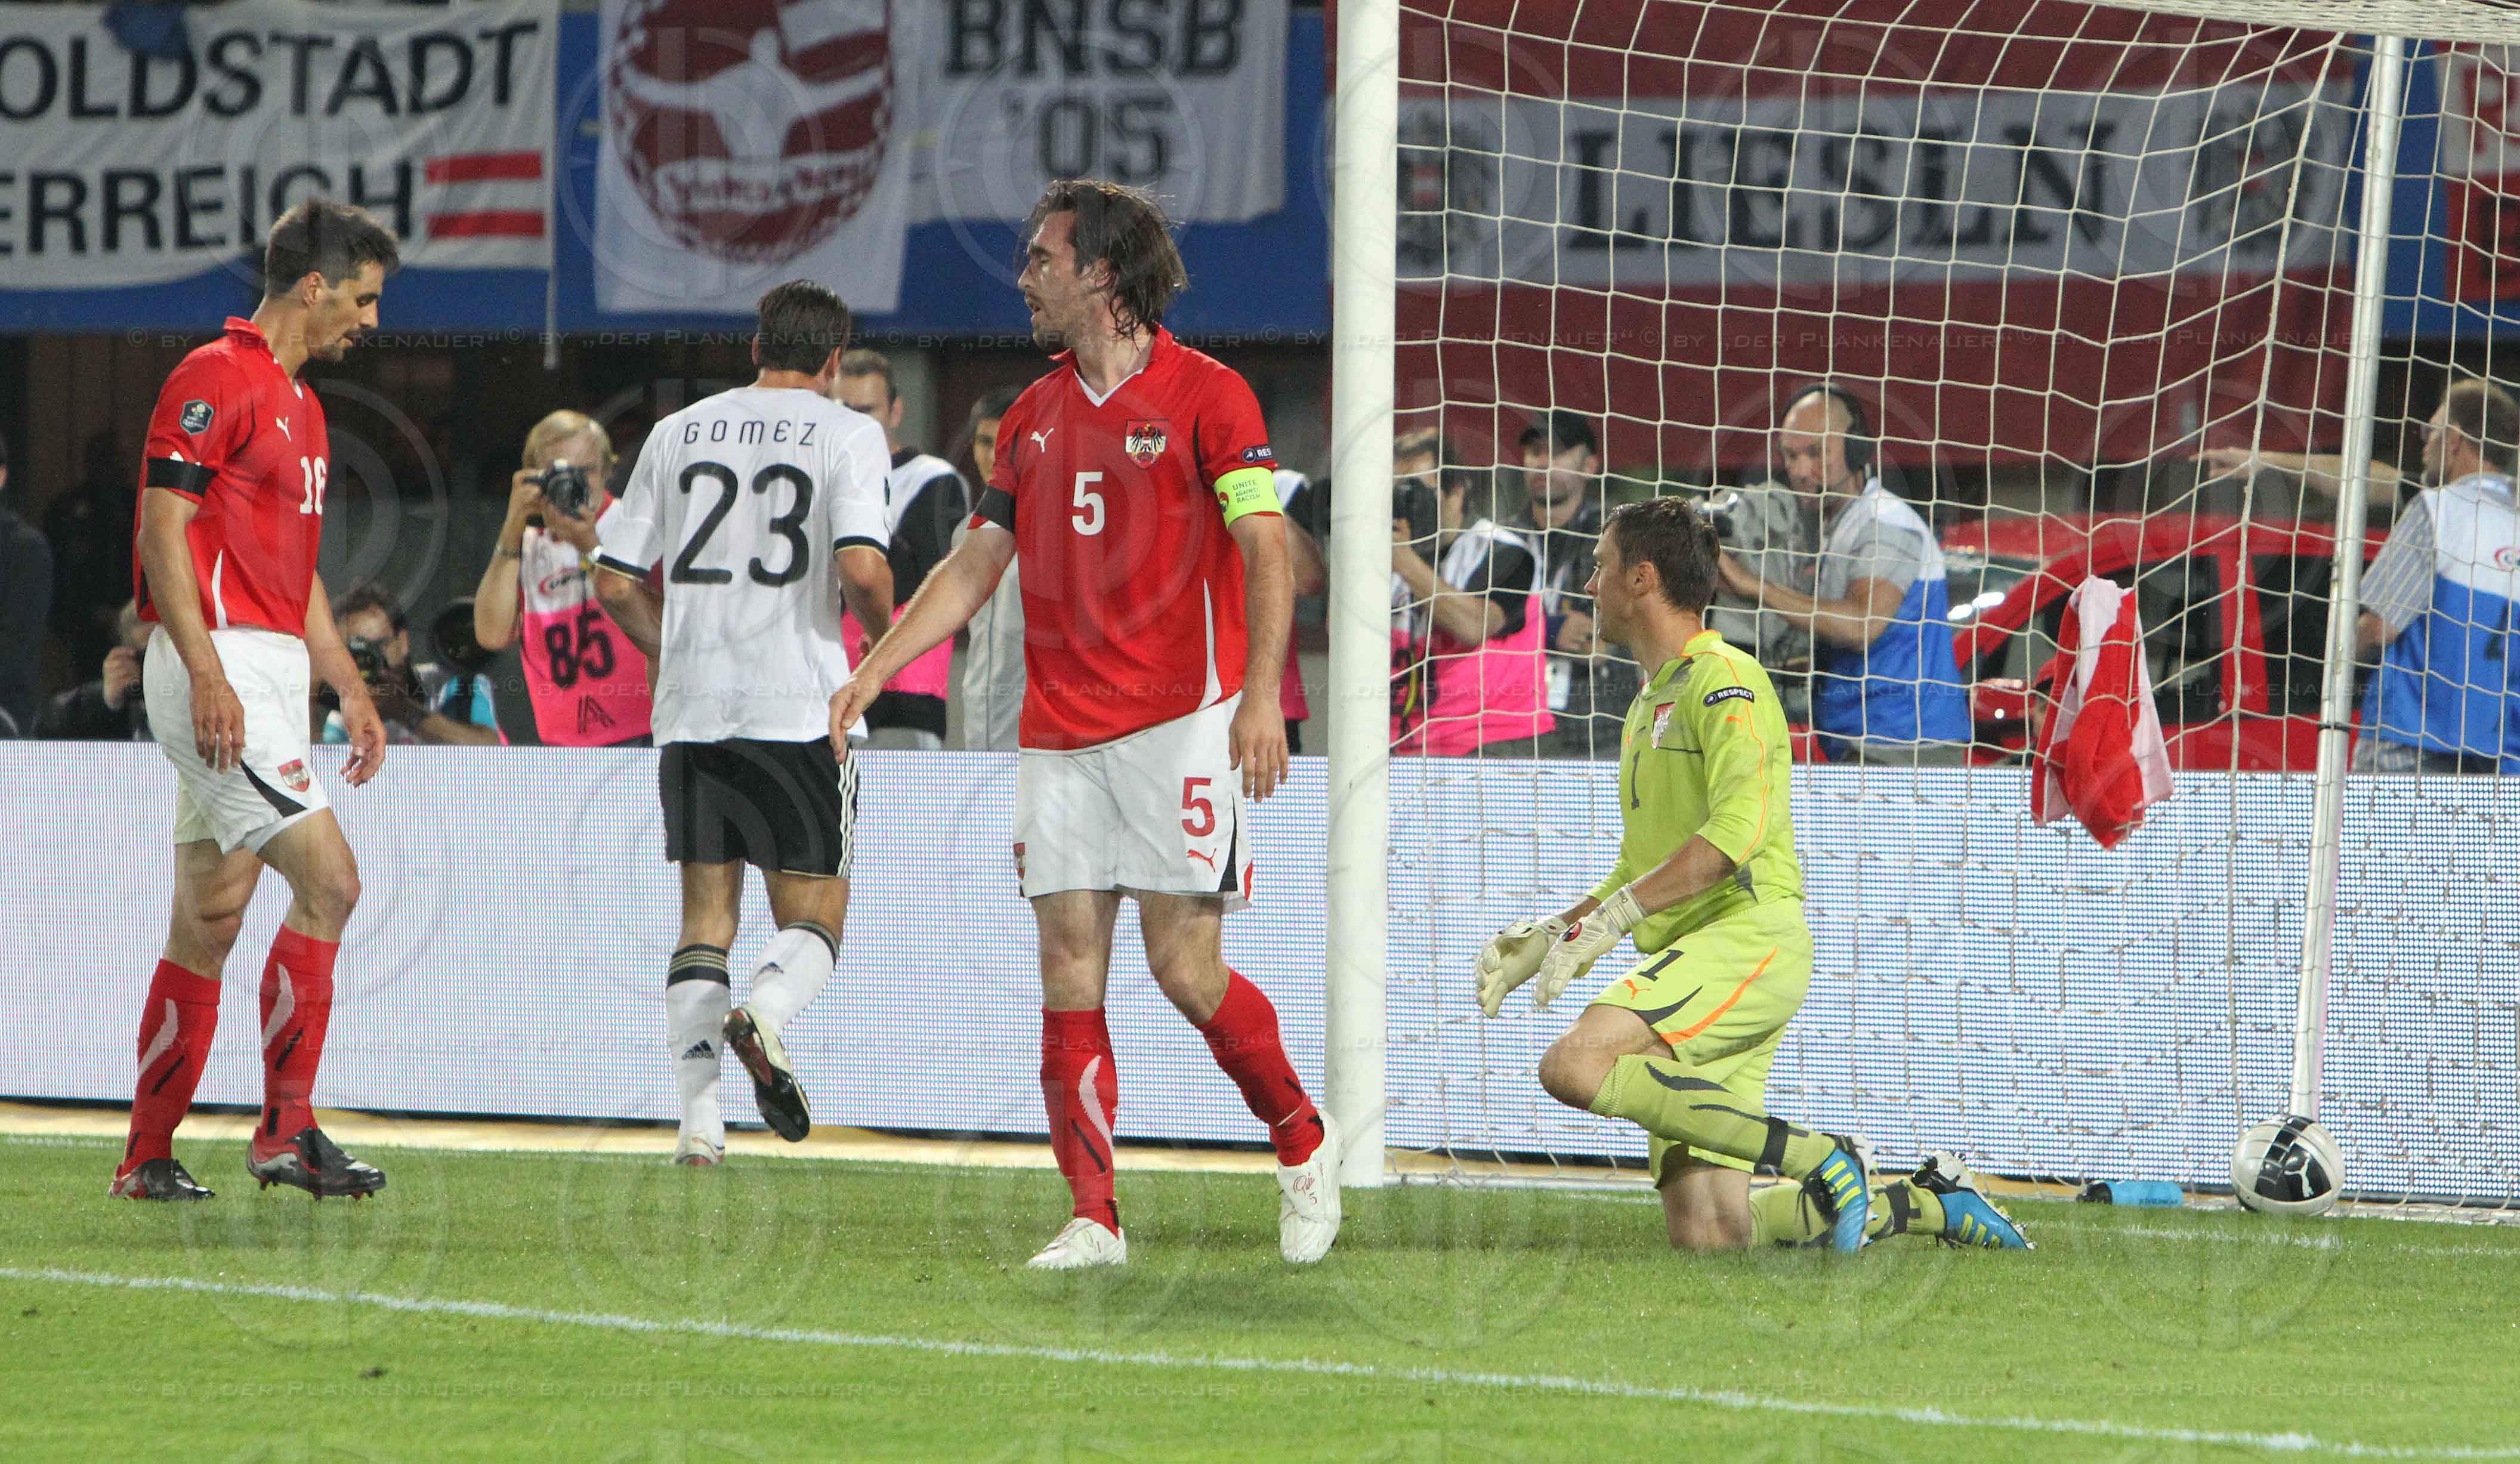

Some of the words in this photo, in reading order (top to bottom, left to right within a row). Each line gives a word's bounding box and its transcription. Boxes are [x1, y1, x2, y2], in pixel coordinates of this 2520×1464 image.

[945, 0, 1244, 78] BNSB
[0, 156, 413, 257] RREICH
[684, 419, 817, 446] GOMEZ
[299, 455, 328, 516] 16
[1071, 471, 1105, 536] 5
[669, 461, 813, 588] 23
[545, 609, 616, 690] 85
[1717, 688, 1753, 700] RESPECT
[1181, 777, 1216, 837] 5
[1636, 949, 1685, 982] 1
